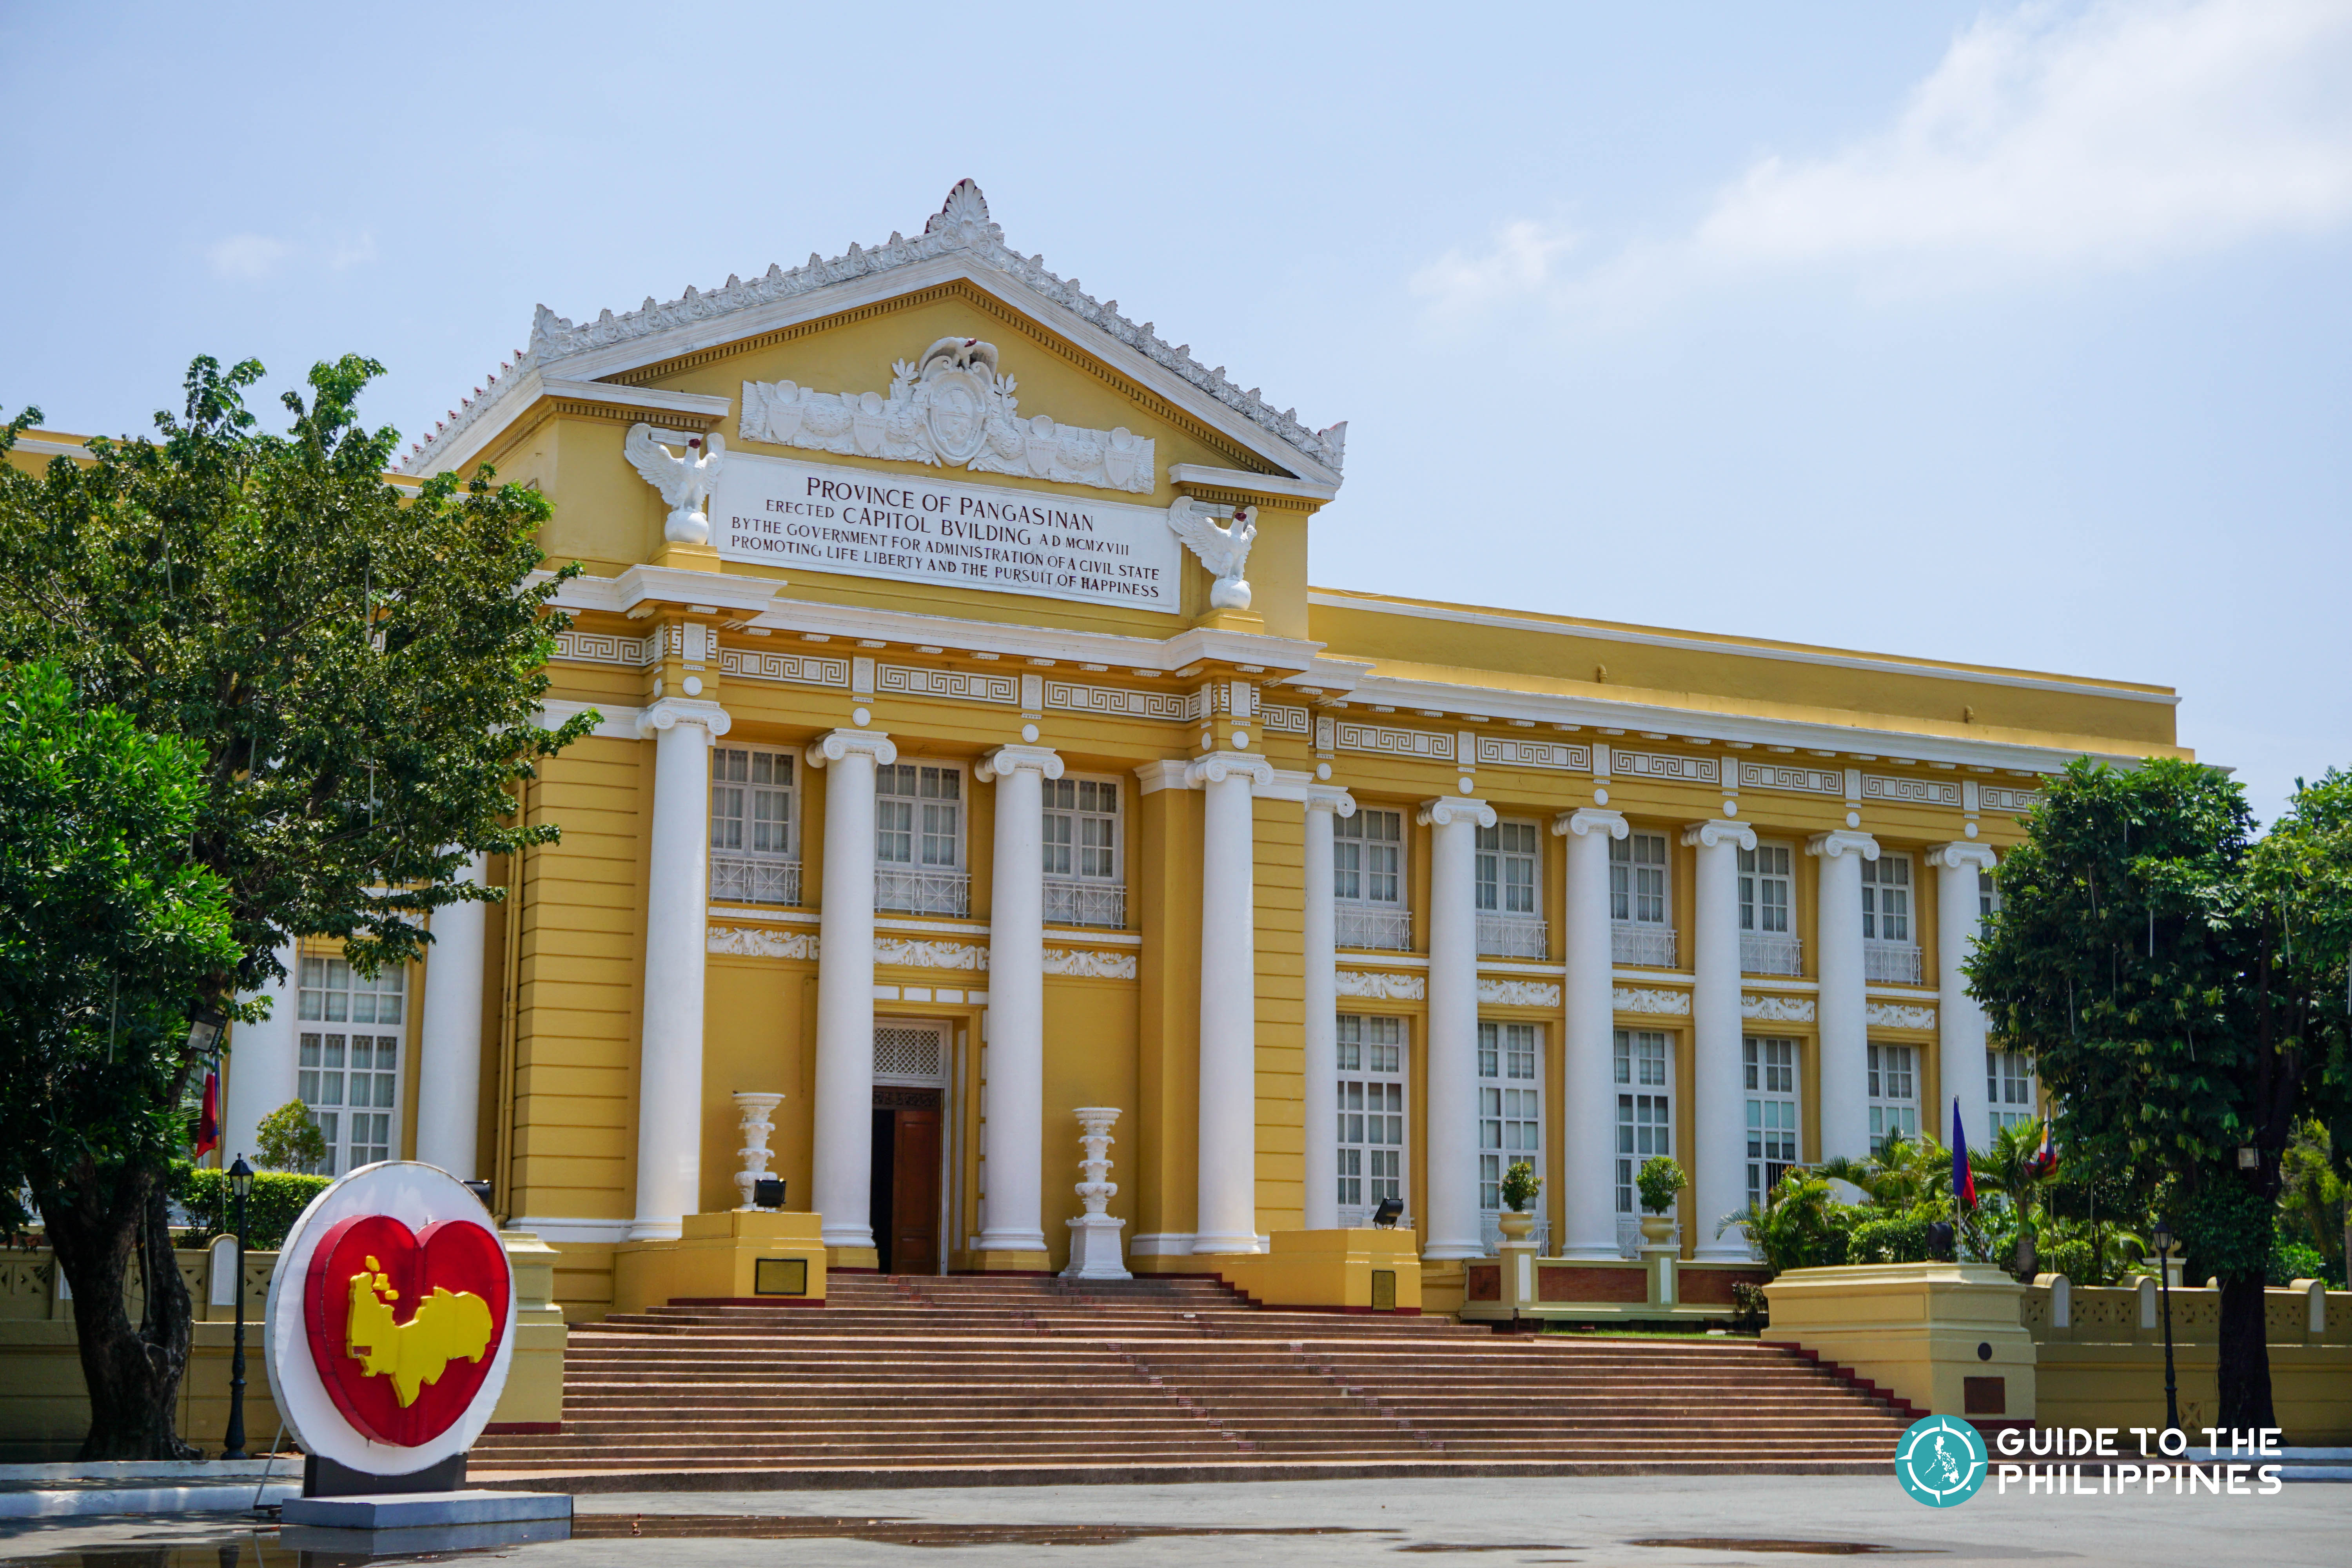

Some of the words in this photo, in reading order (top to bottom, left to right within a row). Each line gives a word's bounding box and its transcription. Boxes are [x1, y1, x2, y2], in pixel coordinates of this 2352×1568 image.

[766, 499, 834, 518] ERECTED
[843, 508, 931, 533] CAPITOL
[941, 519, 1031, 545] BVILDING
[1065, 537, 1129, 555] MCMXVIII
[807, 477, 914, 509] PROVINCE
[922, 494, 951, 513] OF
[960, 497, 1093, 532] PANGASINAN
[731, 535, 821, 557] PROMOTING
[827, 546, 858, 561] LIFE
[864, 551, 922, 569] LIBERTY
[927, 559, 956, 573] AND
[961, 563, 987, 578] THE
[995, 566, 1053, 585] PURSUIT
[1057, 574, 1077, 587] OF
[1081, 577, 1159, 597] HAPPINESS
[787, 523, 887, 547] GOVERNMENT
[892, 536, 921, 553] FOR
[925, 541, 1043, 566] ADMINISTRATION
[1047, 556, 1065, 568] OF
[1067, 558, 1076, 571] A
[1080, 560, 1114, 575] CIVIL
[1118, 564, 1159, 581] STATE
